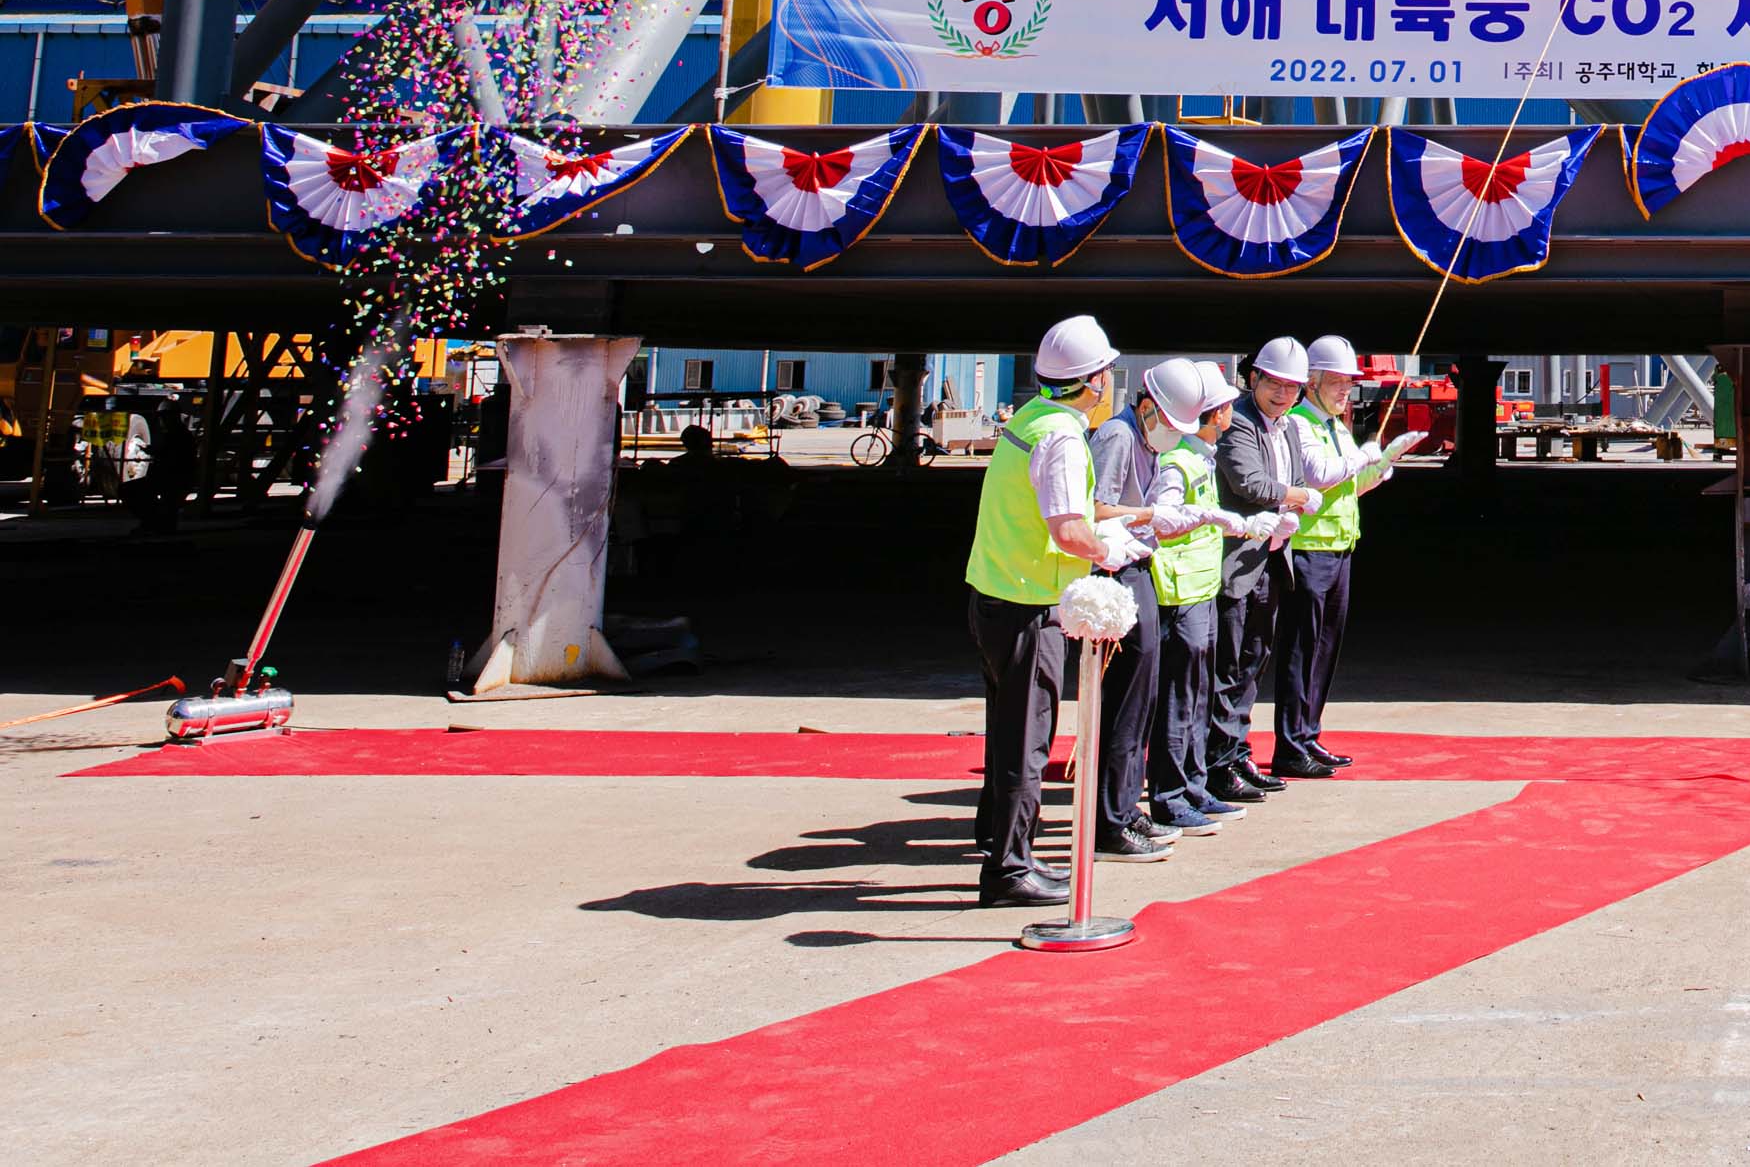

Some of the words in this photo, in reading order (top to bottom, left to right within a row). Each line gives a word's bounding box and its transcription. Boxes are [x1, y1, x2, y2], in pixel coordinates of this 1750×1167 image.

[1269, 58, 1357, 83] 2022.
[1369, 59, 1416, 83] 07.
[1429, 60, 1463, 84] 01
